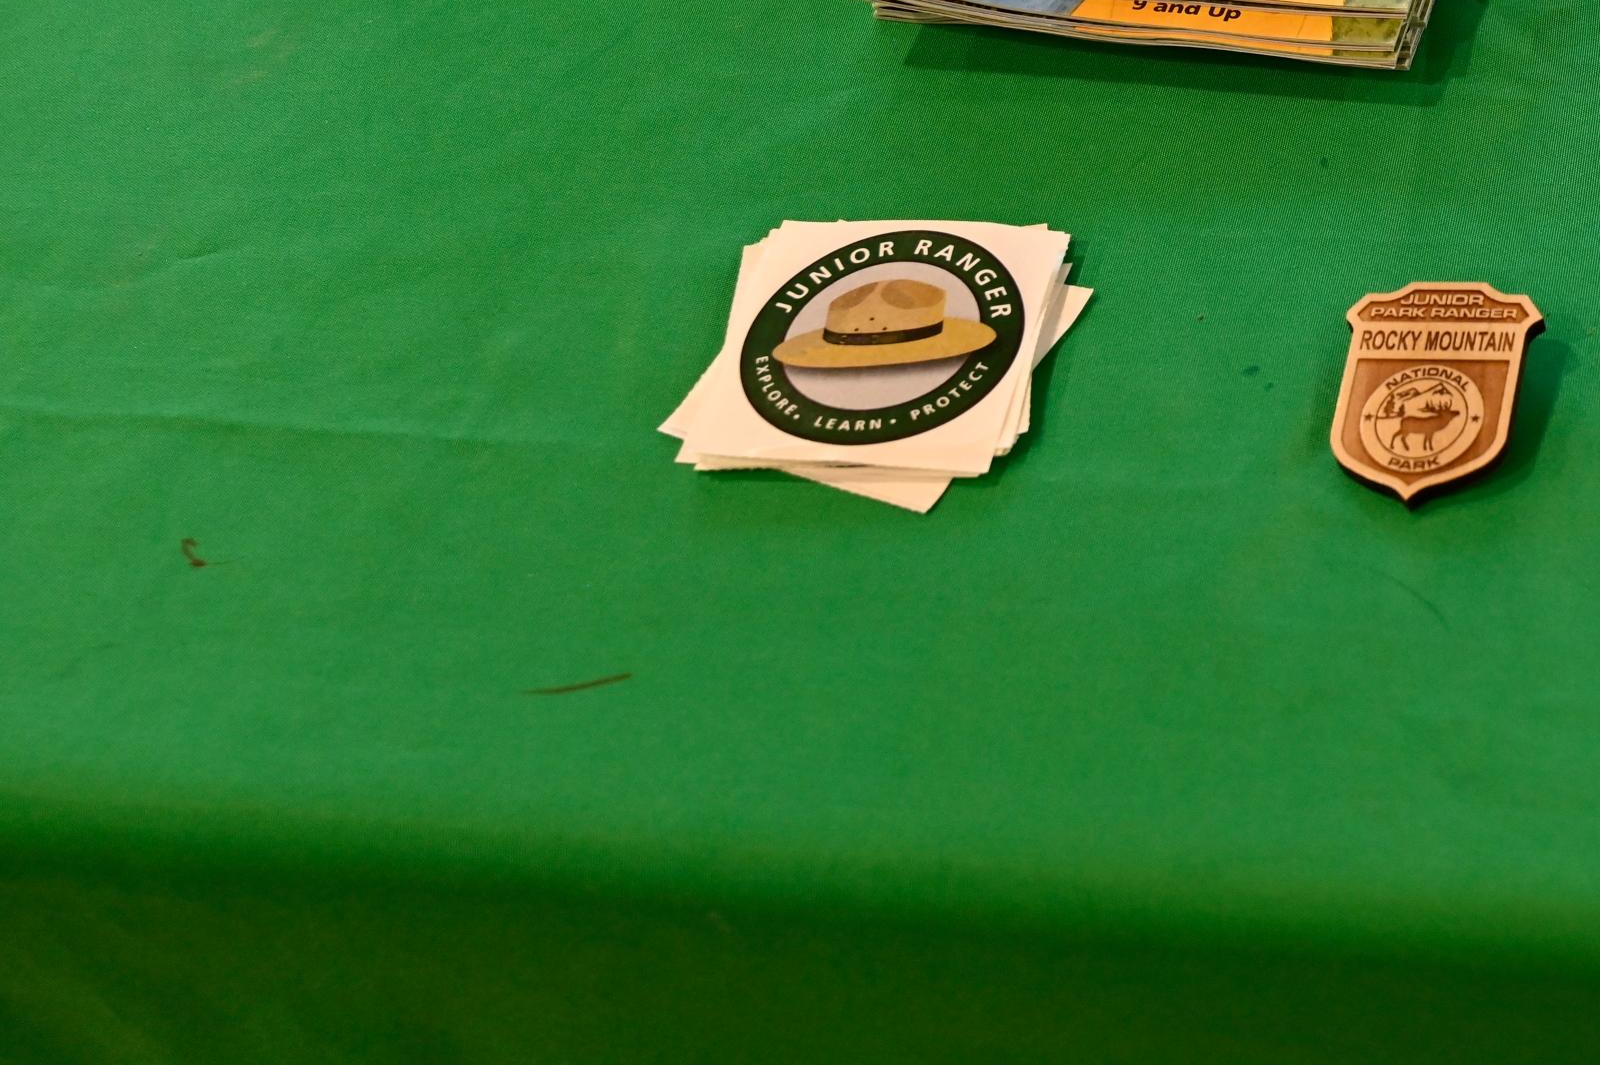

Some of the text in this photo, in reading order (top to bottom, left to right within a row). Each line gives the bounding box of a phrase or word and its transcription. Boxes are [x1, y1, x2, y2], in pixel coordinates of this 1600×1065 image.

[1153, 0, 1202, 17] and
[1208, 5, 1242, 23] Up
[774, 238, 1012, 320] JUNIOR RANGER
[1400, 293, 1485, 306] JUNIOR
[1370, 306, 1518, 319] PARK RANGER
[1359, 329, 1516, 352] ROCKY MOUNTAIN
[1385, 366, 1470, 392] NATIONAL
[813, 414, 883, 432] LEARN
[909, 360, 990, 422] PROTECT
[1387, 455, 1440, 470] PARK
